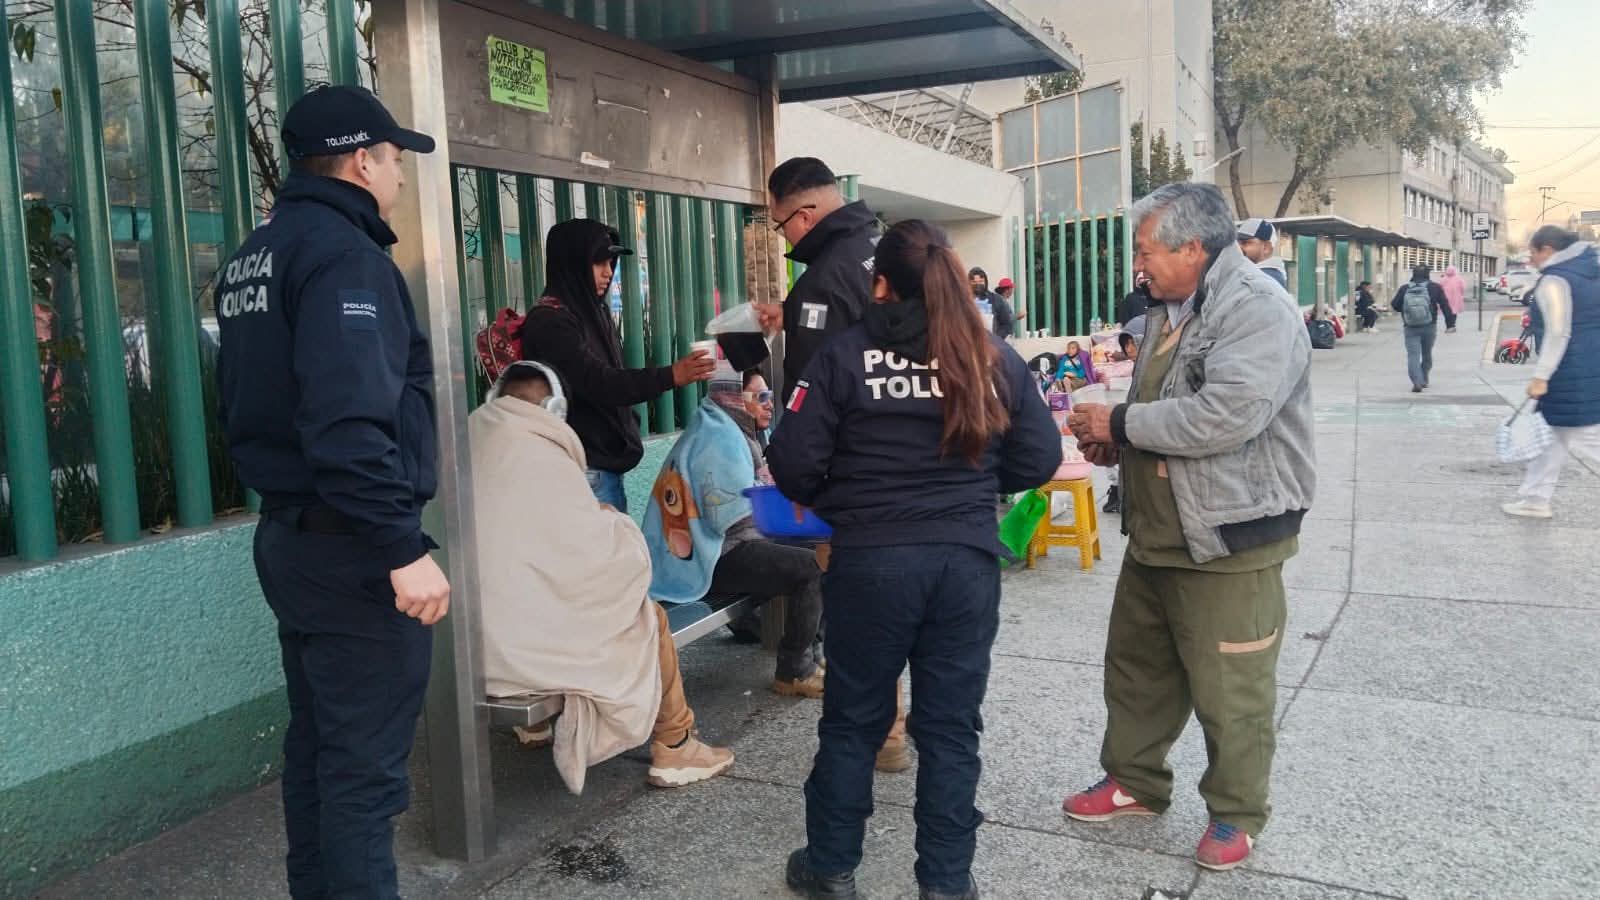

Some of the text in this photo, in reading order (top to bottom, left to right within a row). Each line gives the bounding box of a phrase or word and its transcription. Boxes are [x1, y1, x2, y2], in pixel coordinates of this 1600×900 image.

[495, 41, 518, 56] CLUB
[226, 246, 273, 284] OLICÍA
[220, 285, 268, 318] OLUCA
